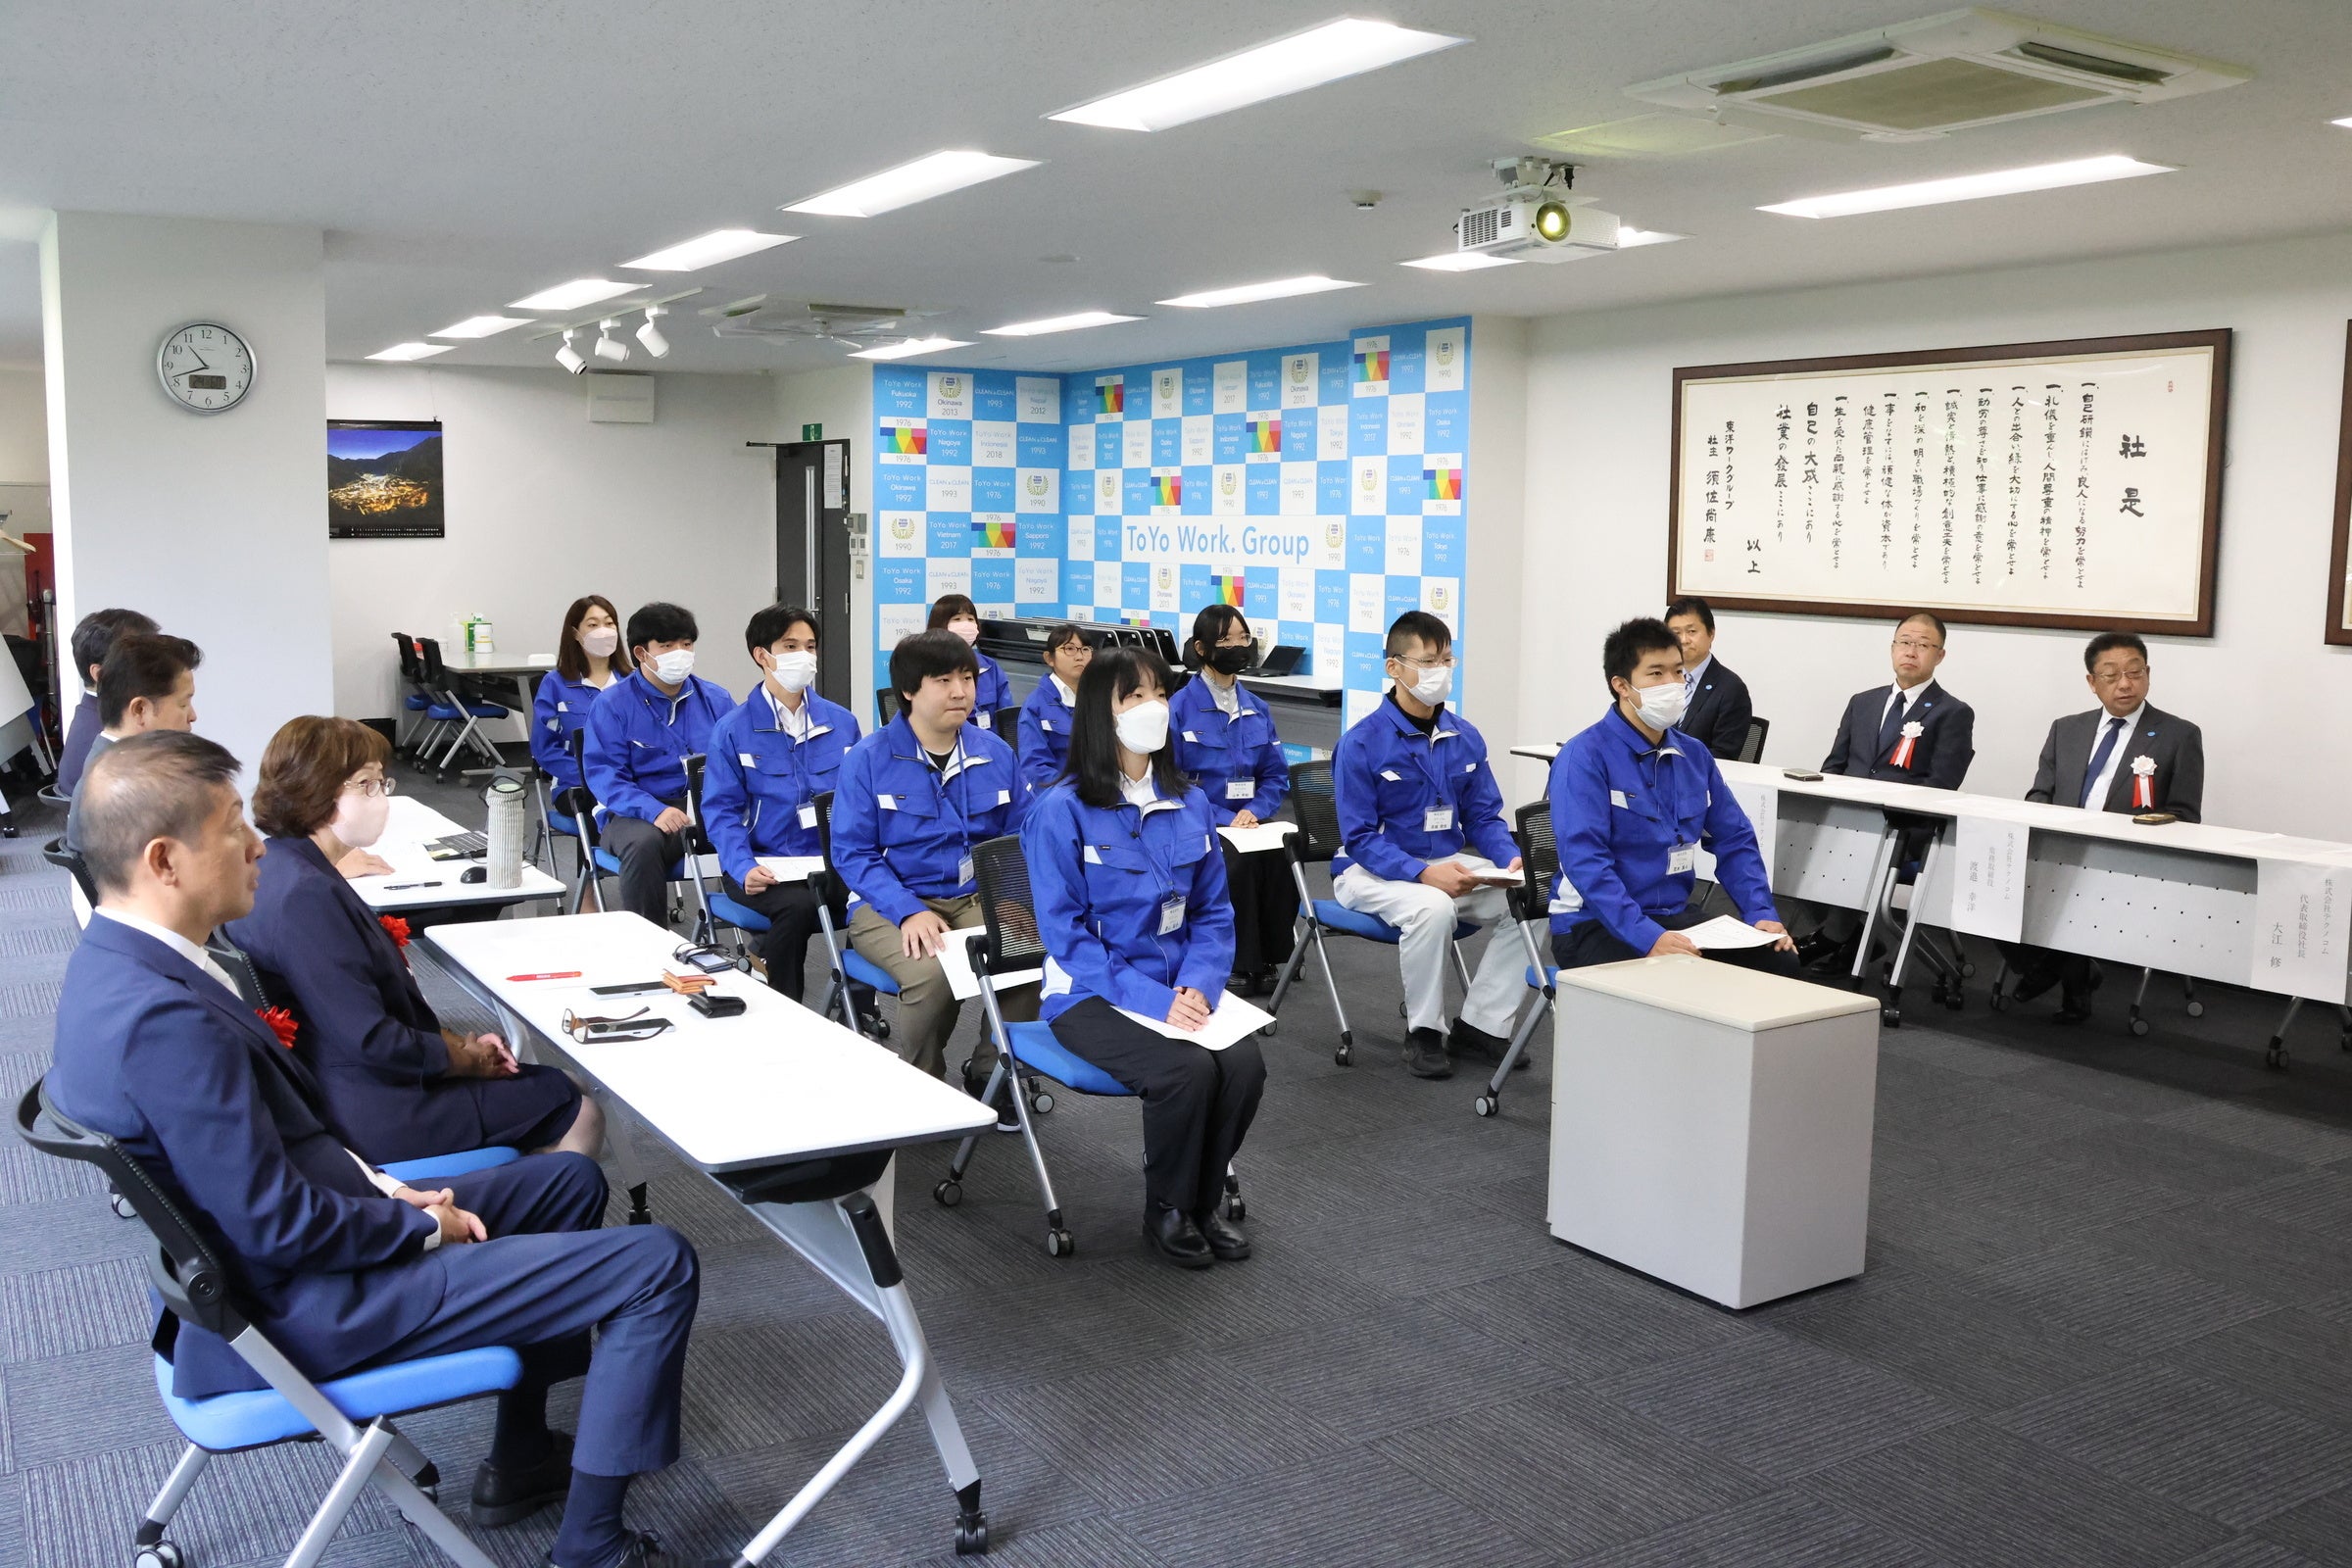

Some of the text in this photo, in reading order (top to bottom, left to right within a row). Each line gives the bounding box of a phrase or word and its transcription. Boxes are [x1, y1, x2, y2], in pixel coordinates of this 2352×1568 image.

[184, 333, 193, 343] 11
[201, 330, 212, 339] 12
[223, 336, 227, 344] 1
[172, 345, 182, 354] 10
[236, 348, 241, 357] 2
[166, 362, 173, 370] 9
[241, 365, 247, 373] 3
[1401, 365, 1414, 373] 1993
[173, 379, 180, 387] 8
[188, 391, 193, 400] 7
[223, 392, 229, 401] 5
[205, 397, 211, 406] 6
[1437, 429, 1450, 438] 1992
[1257, 491, 1268, 499] 1993
[1292, 490, 1304, 498] 1993
[1329, 490, 1342, 498] 1976
[1399, 487, 1411, 495] 1993
[895, 543, 912, 551] 1990
[1127, 525, 1170, 552] ToYo
[1177, 525, 1236, 554] Work.
[1243, 526, 1309, 564] Group
[1397, 547, 1410, 556] 1976
[1328, 553, 1341, 562] 1990
[1255, 595, 1267, 603] 1993
[1327, 599, 1340, 607] 1976
[2272, 922, 2283, 944] 大江
